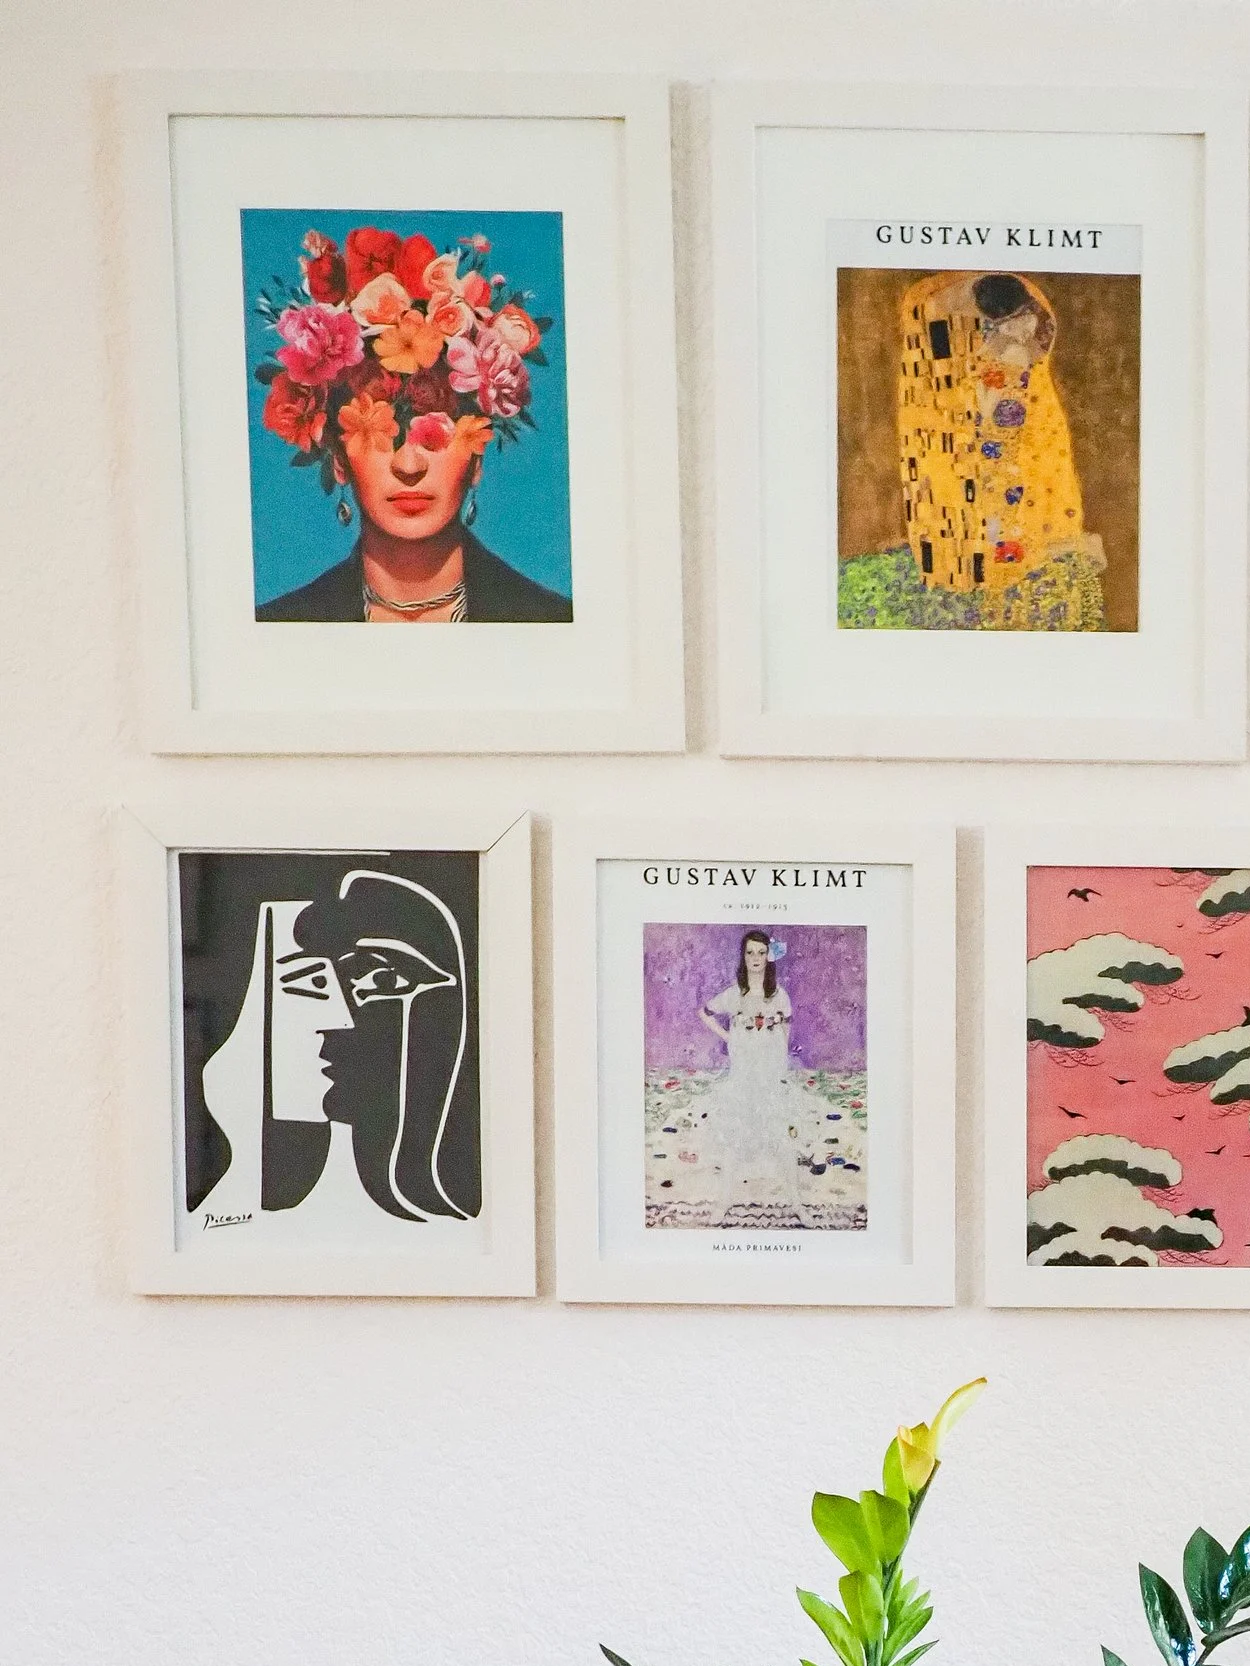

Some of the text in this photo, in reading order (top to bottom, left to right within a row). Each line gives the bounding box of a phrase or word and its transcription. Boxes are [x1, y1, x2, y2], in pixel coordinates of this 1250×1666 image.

[875, 224, 1103, 249] GUSTAV KLIMT
[643, 866, 867, 888] GUSTAV KLIMT
[746, 1244, 802, 1252] PRIMAVESI
